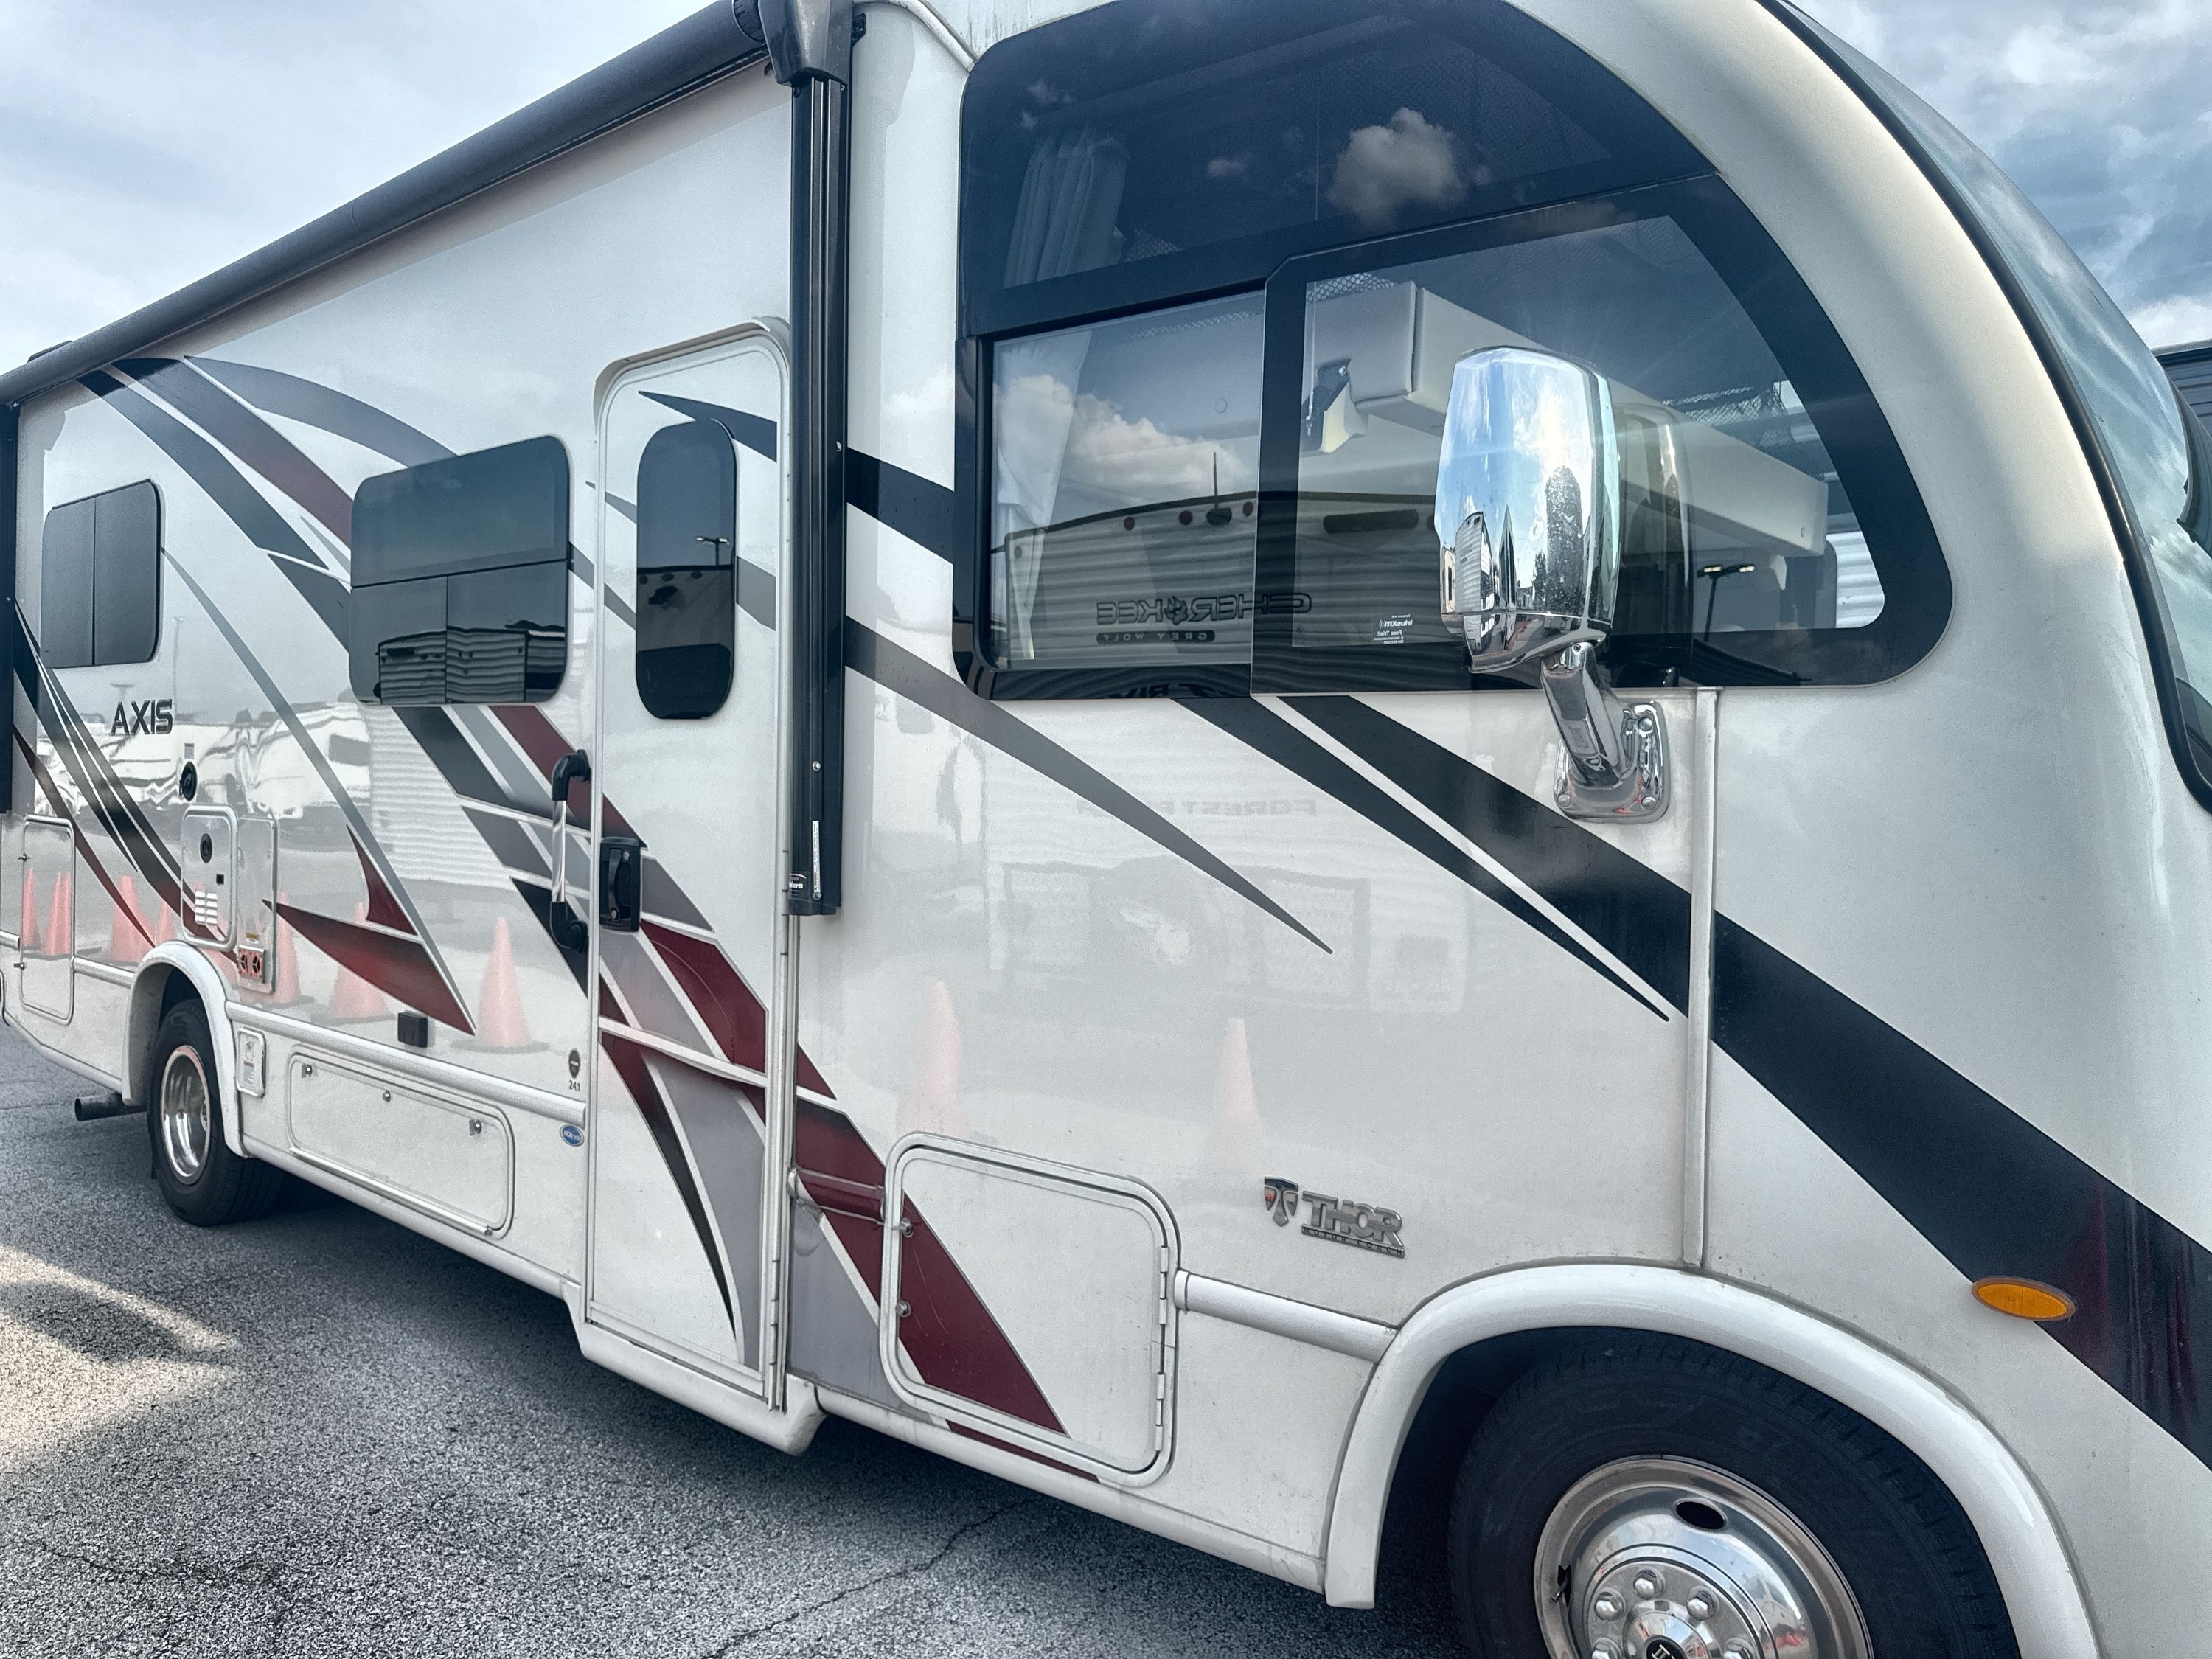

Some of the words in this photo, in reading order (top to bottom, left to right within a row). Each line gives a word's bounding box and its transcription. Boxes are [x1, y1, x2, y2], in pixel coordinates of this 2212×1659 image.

[109, 698, 173, 736] AXIS
[568, 1079, 580, 1092] 24.1
[1301, 1190, 1404, 1248] THOR
[1301, 1226, 1347, 1243] MOTOR
[1357, 1239, 1403, 1256] COACH
